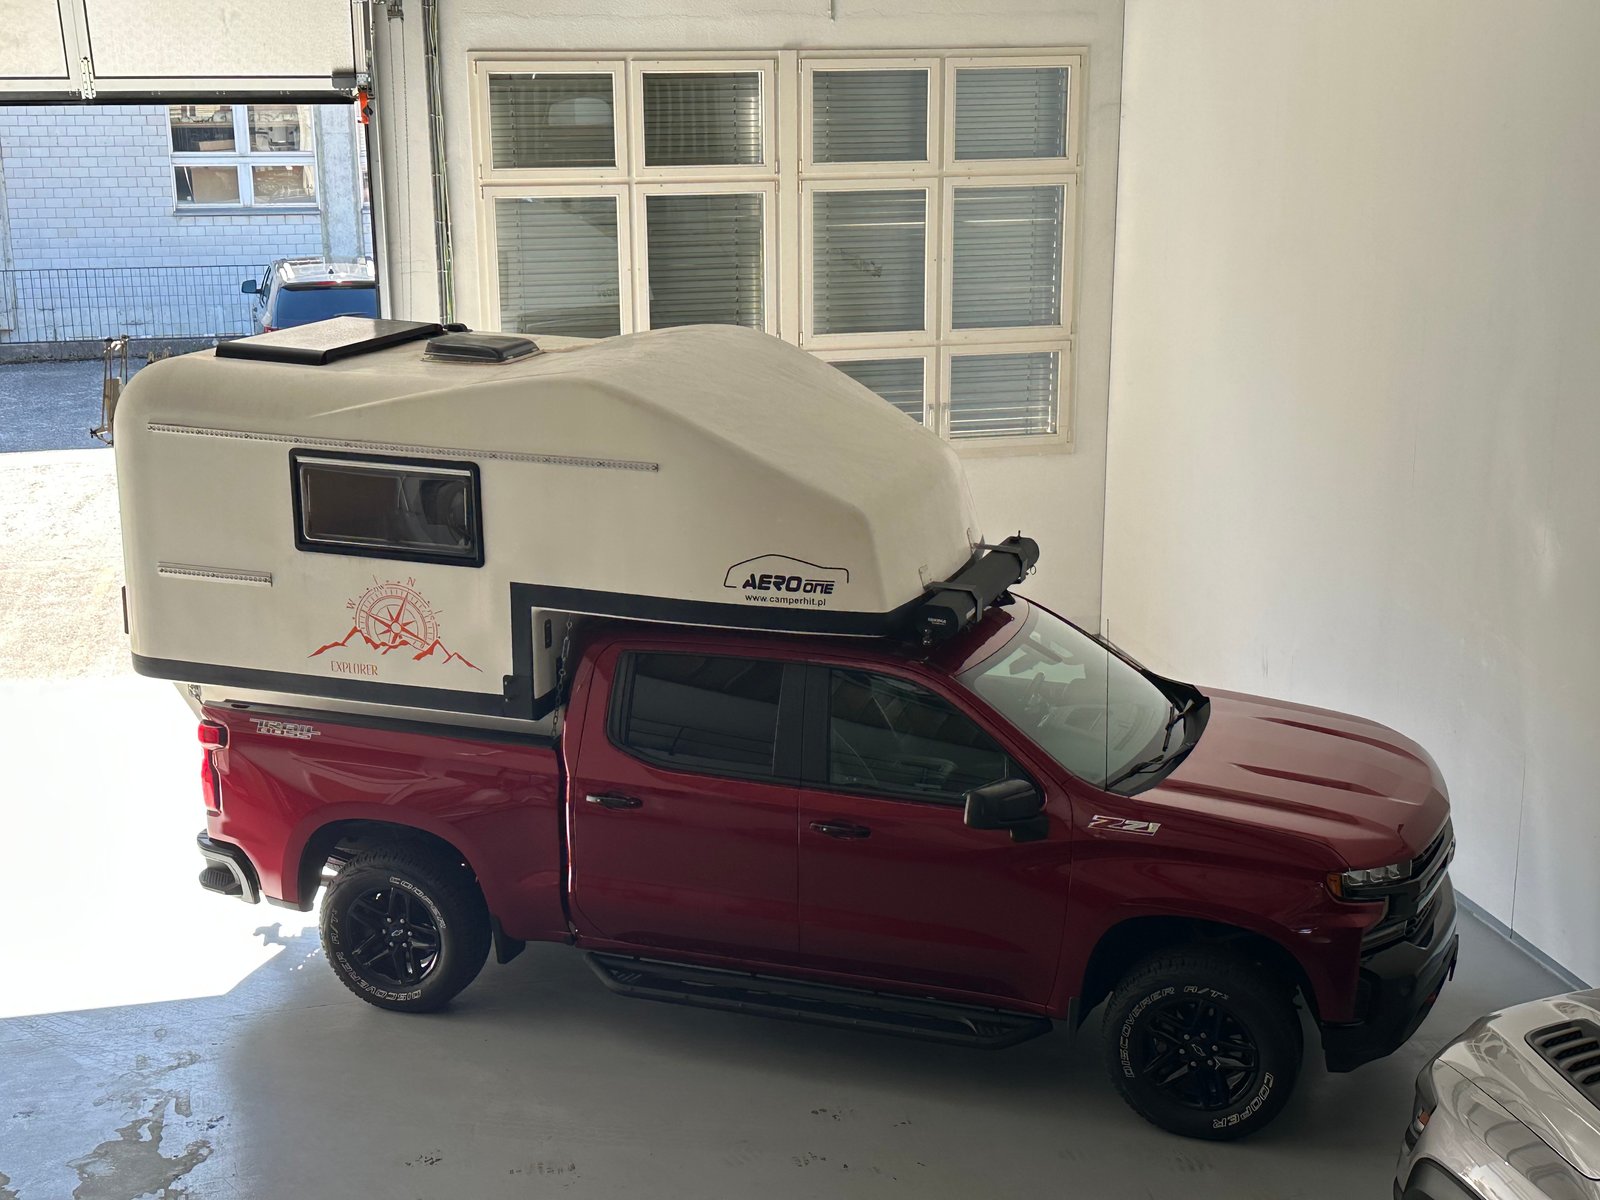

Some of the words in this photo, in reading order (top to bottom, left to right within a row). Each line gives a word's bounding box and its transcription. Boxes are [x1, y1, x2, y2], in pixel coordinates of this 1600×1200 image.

[742, 573, 802, 593] AERO
[745, 594, 826, 607] www.camperhit.pl
[330, 660, 379, 676] EXPLORER
[1088, 814, 1162, 837] Z71
[389, 876, 447, 929] COOPER
[335, 951, 422, 1001] DISCOVERER
[1119, 986, 1175, 1079] DISCOVERER
[1212, 1072, 1274, 1129] COOPER
